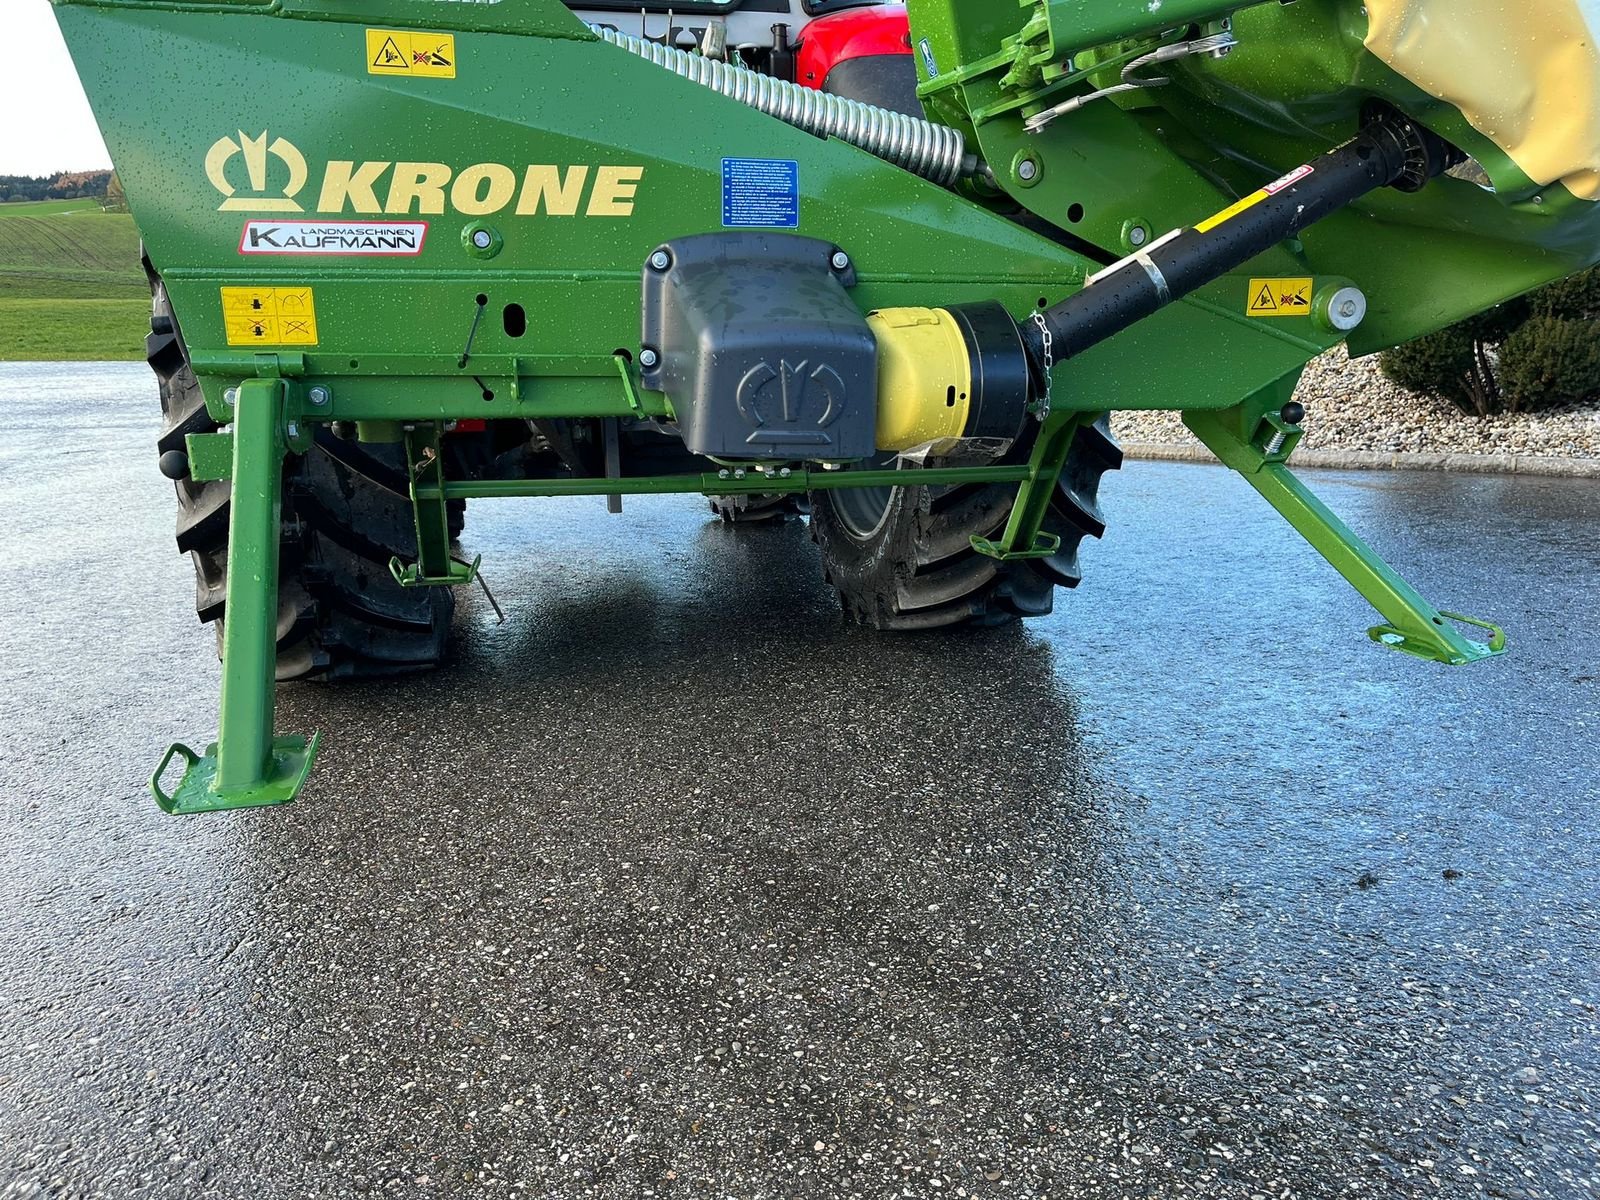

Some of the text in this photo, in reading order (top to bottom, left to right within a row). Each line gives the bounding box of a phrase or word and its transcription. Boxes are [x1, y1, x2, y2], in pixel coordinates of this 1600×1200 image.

[316, 160, 644, 216] KRONE
[249, 227, 415, 249] KAUFMANN
[300, 228, 415, 236] LANDMASCHINEN
